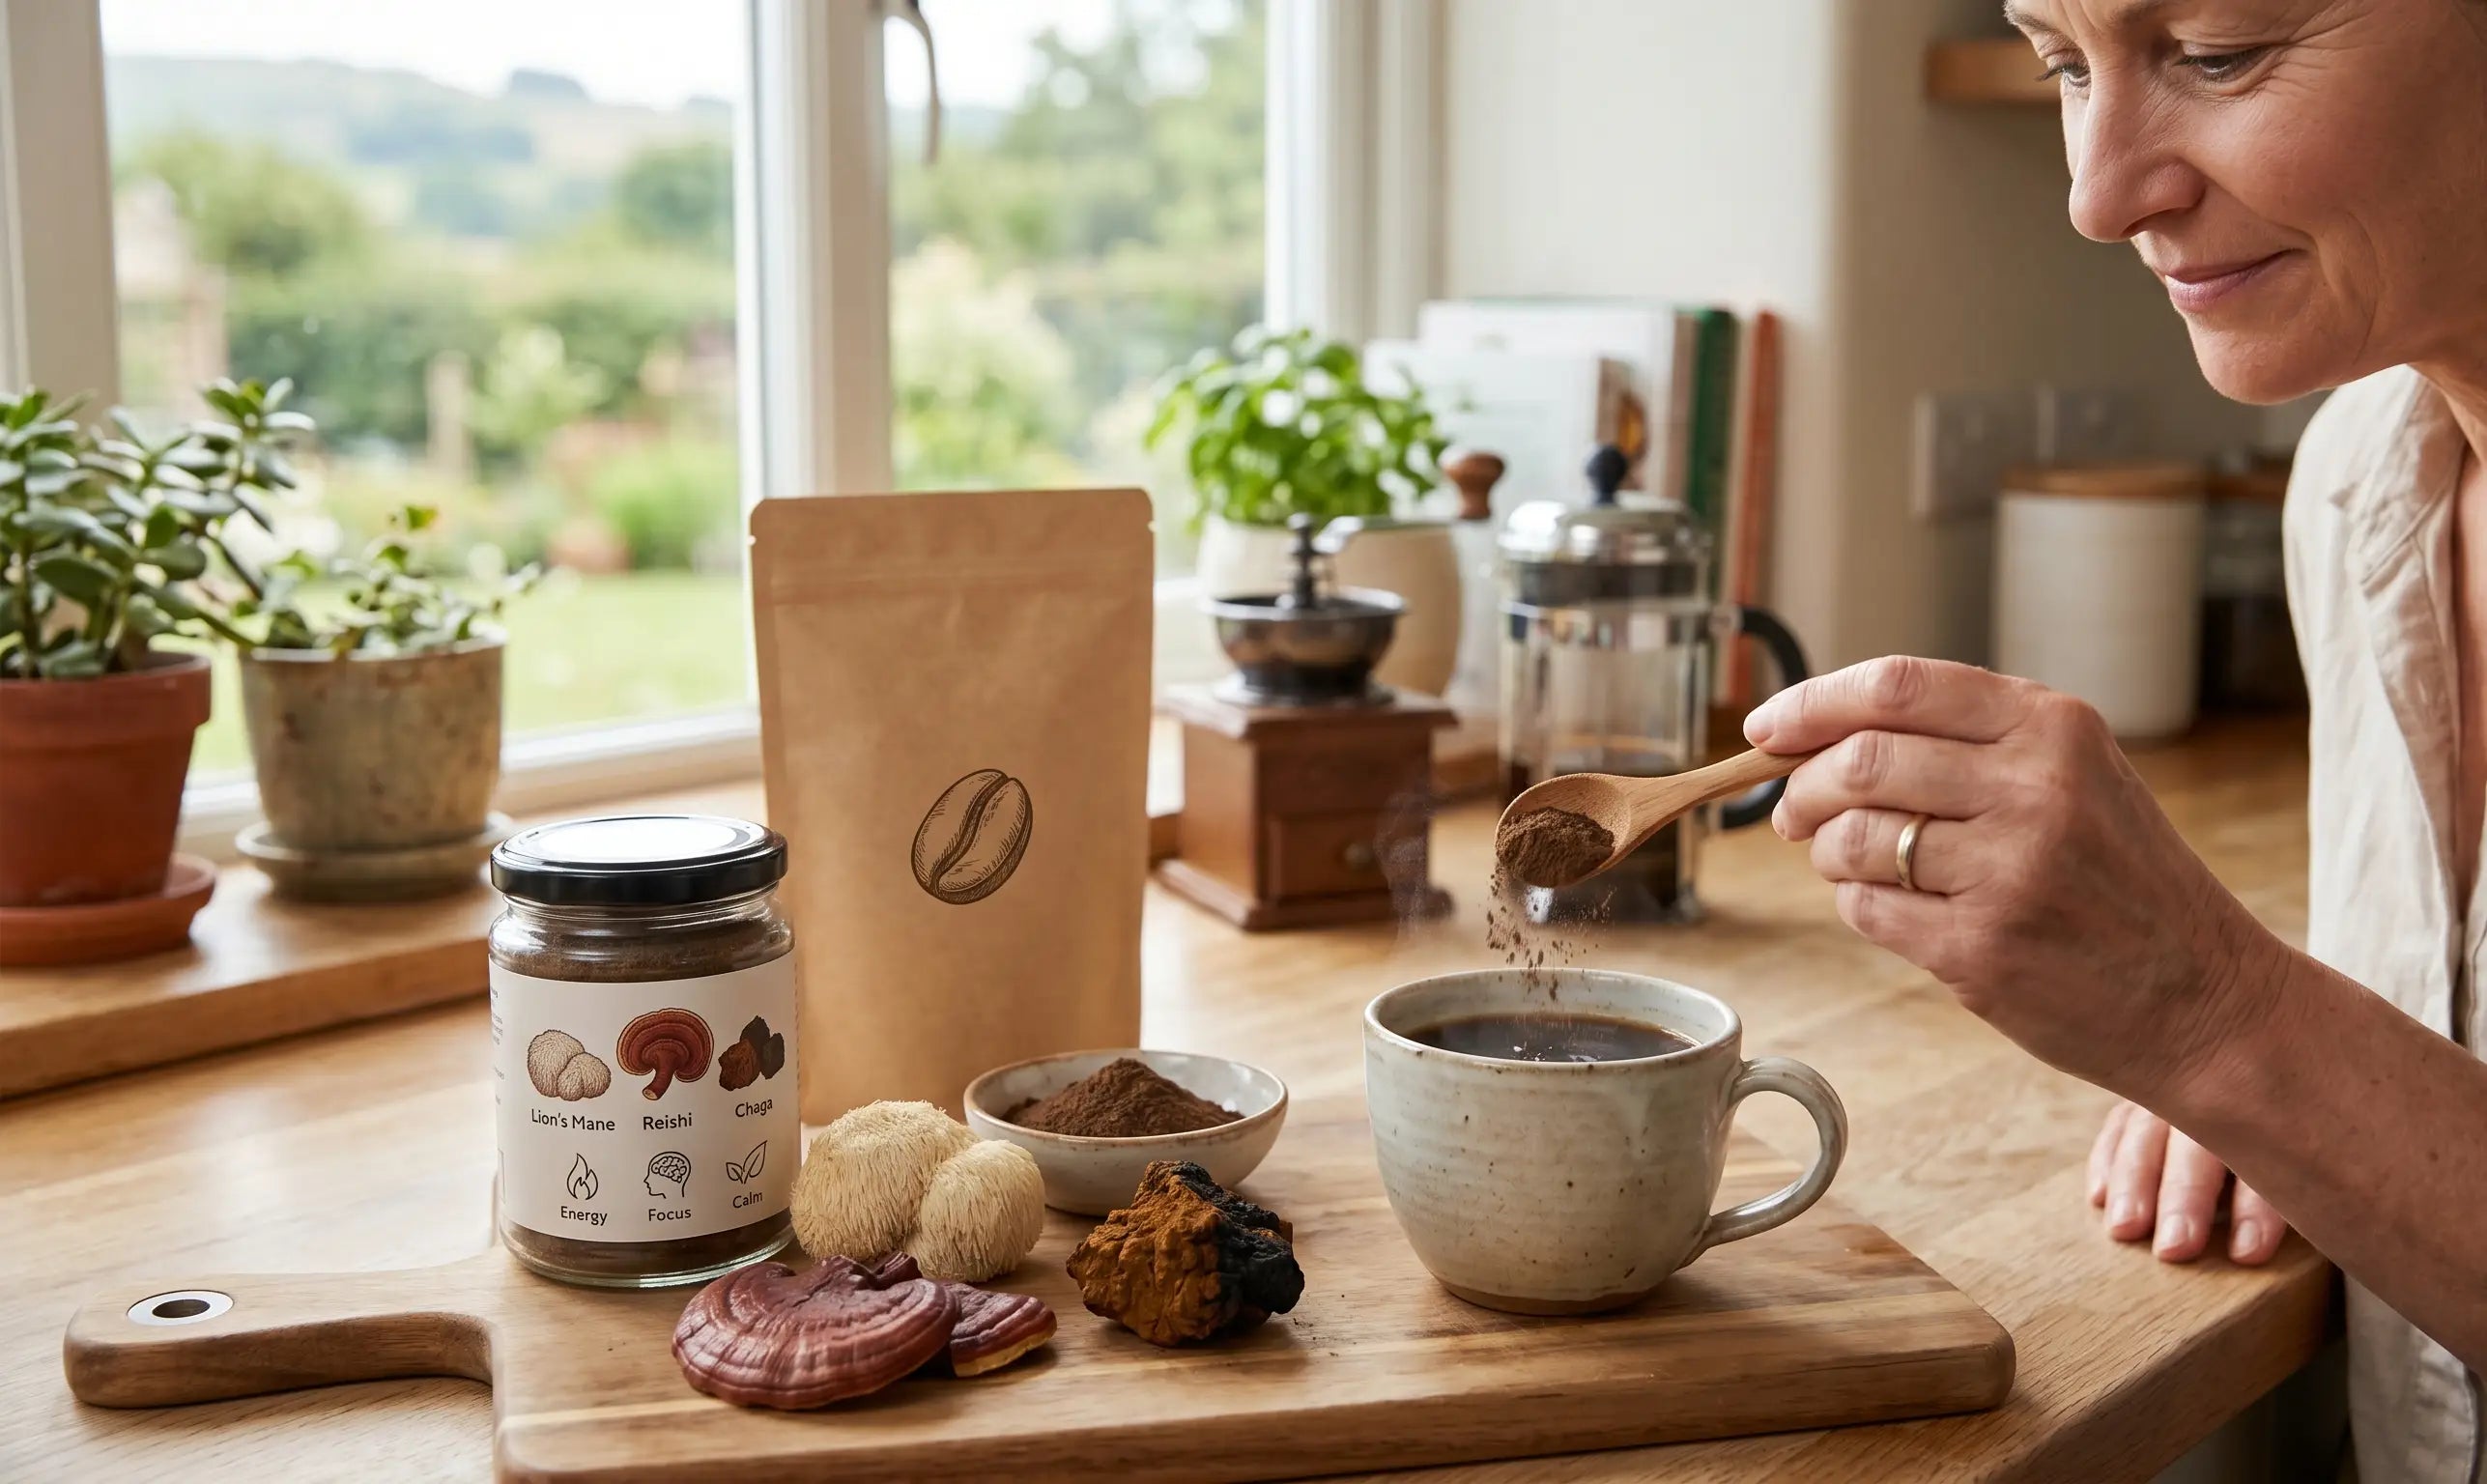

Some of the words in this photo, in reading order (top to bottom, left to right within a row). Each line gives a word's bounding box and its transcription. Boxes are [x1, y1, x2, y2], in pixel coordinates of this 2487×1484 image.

[734, 1099, 773, 1118] Chaga
[531, 1108, 568, 1128] Lion's
[572, 1114, 615, 1131] Mane
[643, 1112, 693, 1130] Reishi
[732, 1191, 763, 1209] Calm
[560, 1206, 608, 1227] Energy
[648, 1208, 692, 1222] Focus
